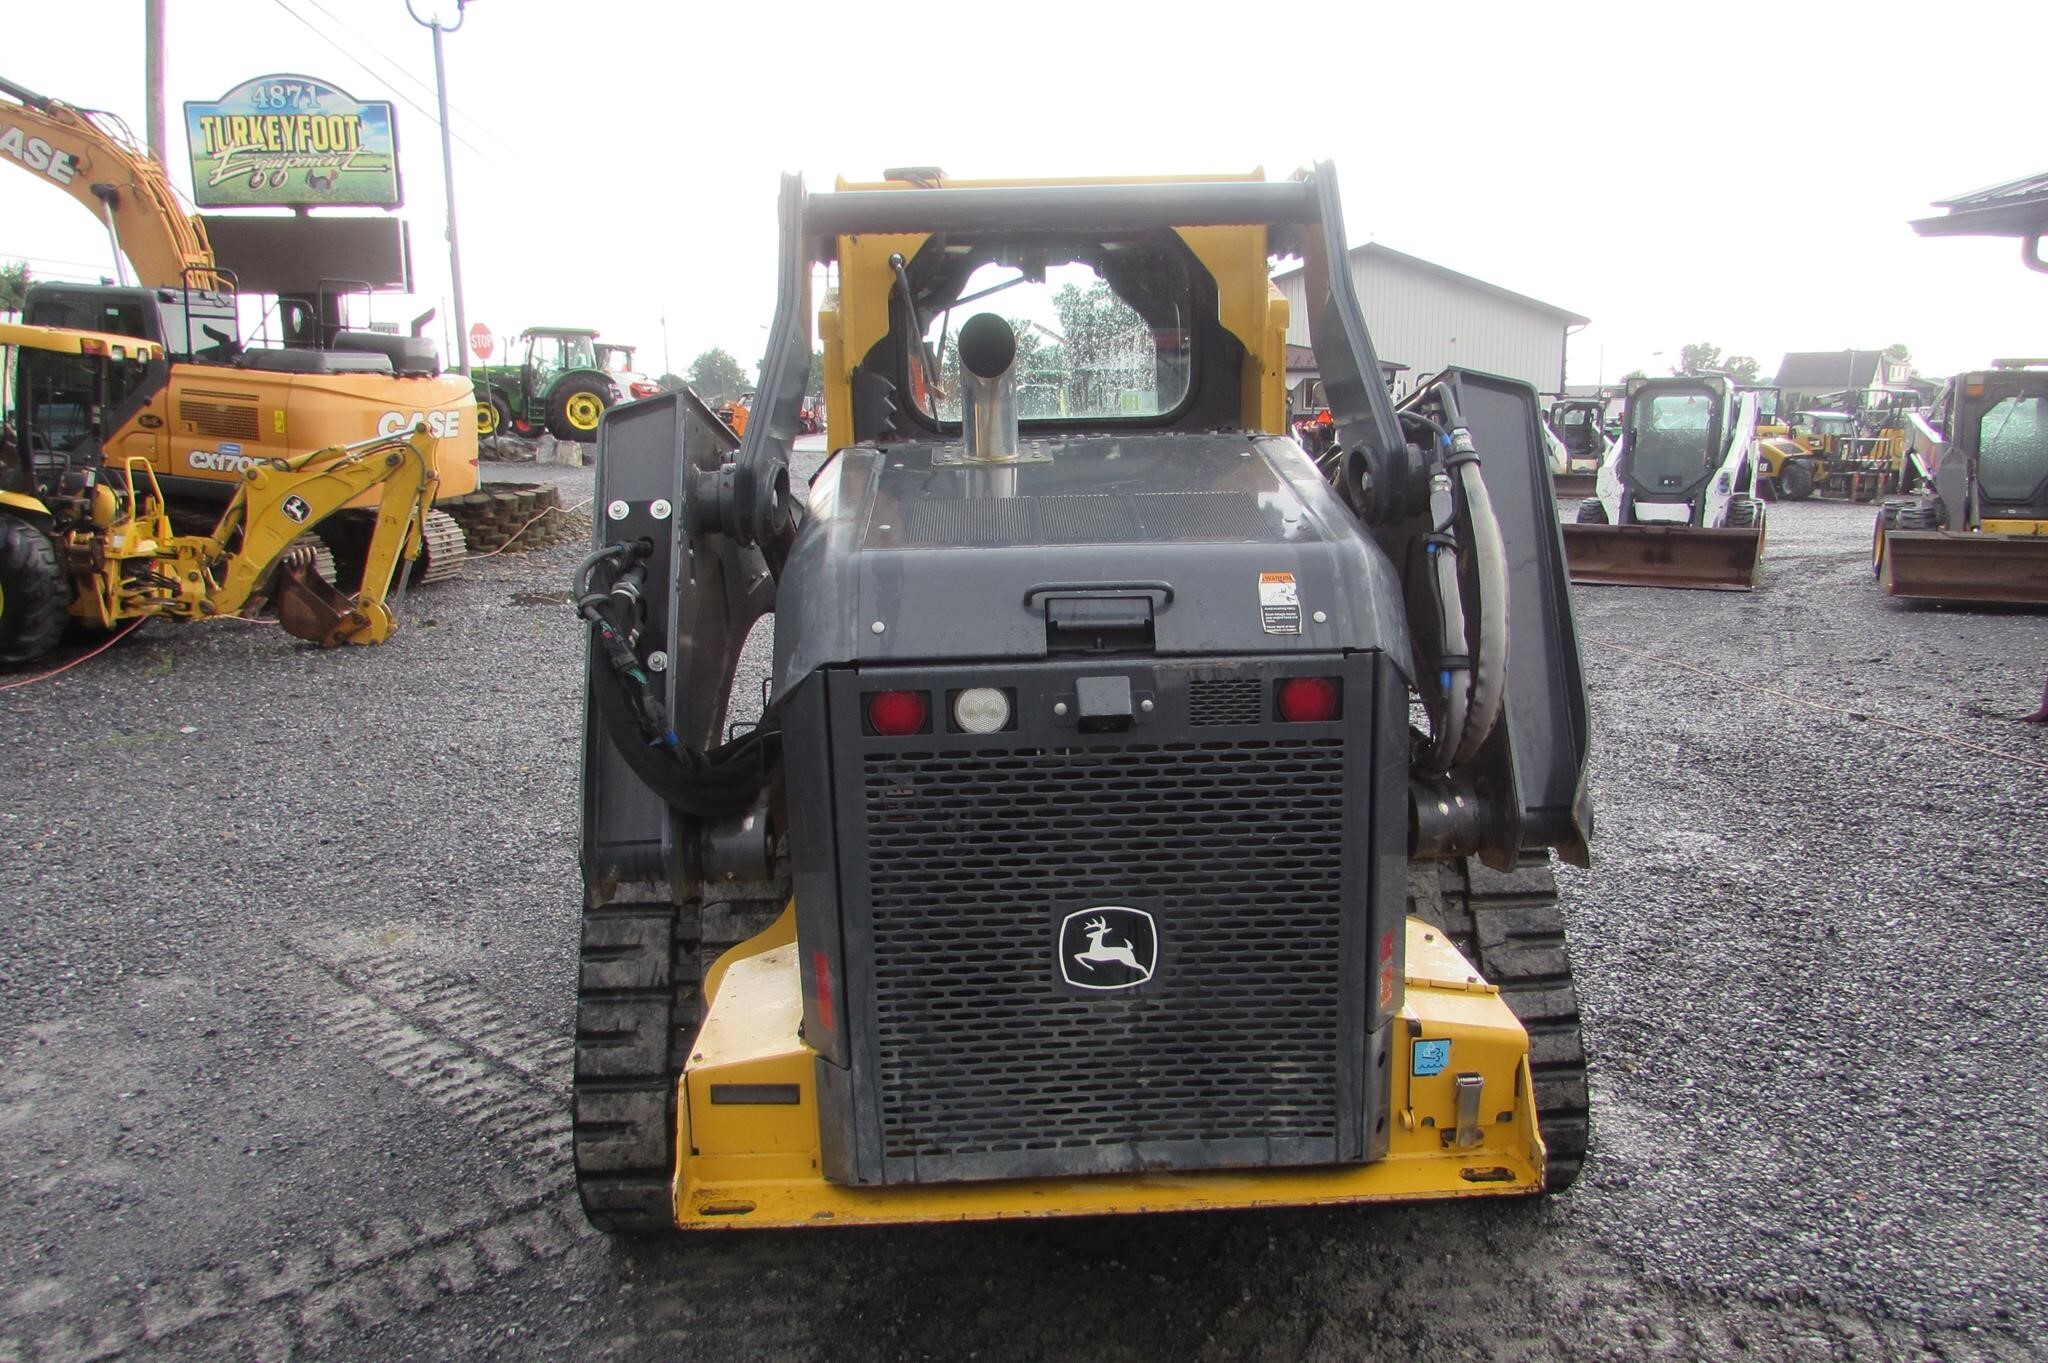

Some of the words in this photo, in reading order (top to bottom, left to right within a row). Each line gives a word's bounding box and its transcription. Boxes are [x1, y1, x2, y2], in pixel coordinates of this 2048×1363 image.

[252, 85, 321, 109] 4871
[200, 114, 361, 153] TURKEYFOOT
[0, 126, 74, 185] ASE
[208, 139, 391, 190] Equipment
[472, 334, 492, 348] STOP
